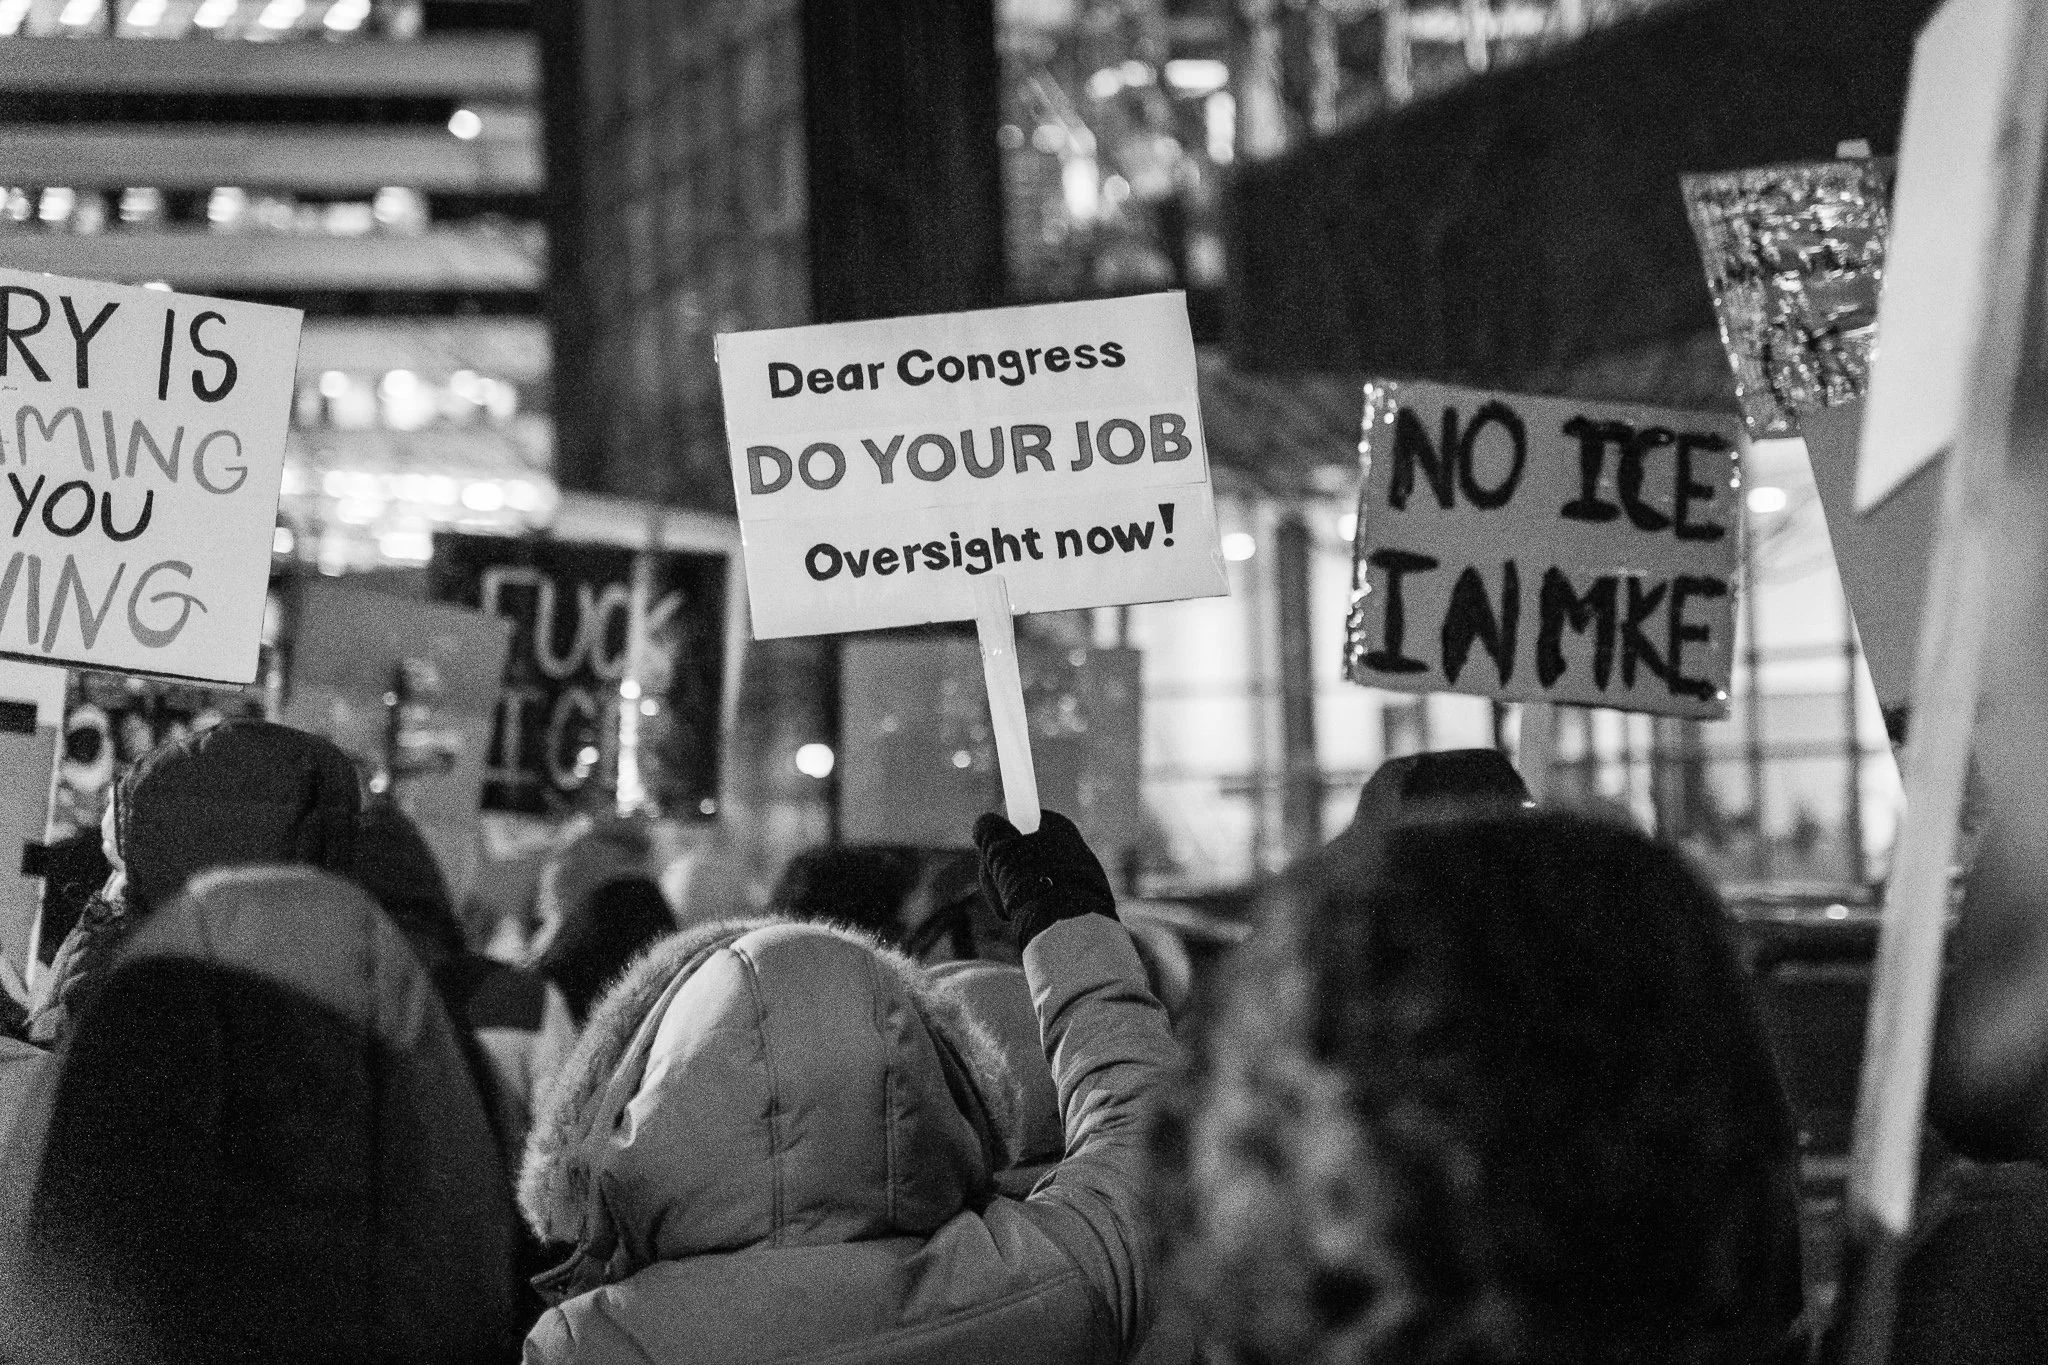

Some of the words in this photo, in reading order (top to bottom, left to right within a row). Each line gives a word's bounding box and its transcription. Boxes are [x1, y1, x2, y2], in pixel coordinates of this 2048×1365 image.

[158, 308, 238, 403] IS
[768, 359, 885, 399] Dear
[897, 341, 1126, 386] Congress
[0, 405, 248, 495] MING
[746, 442, 847, 496] DO
[861, 423, 1056, 485] YOUR
[1070, 412, 1193, 473] JOB
[1388, 400, 1527, 511] NO
[1561, 415, 1733, 542] ICE
[8, 472, 154, 542] YOU
[804, 527, 1044, 582] Oversight
[1055, 502, 1176, 560] now!
[1357, 548, 1521, 689] IN
[1536, 565, 1729, 701] MKE
